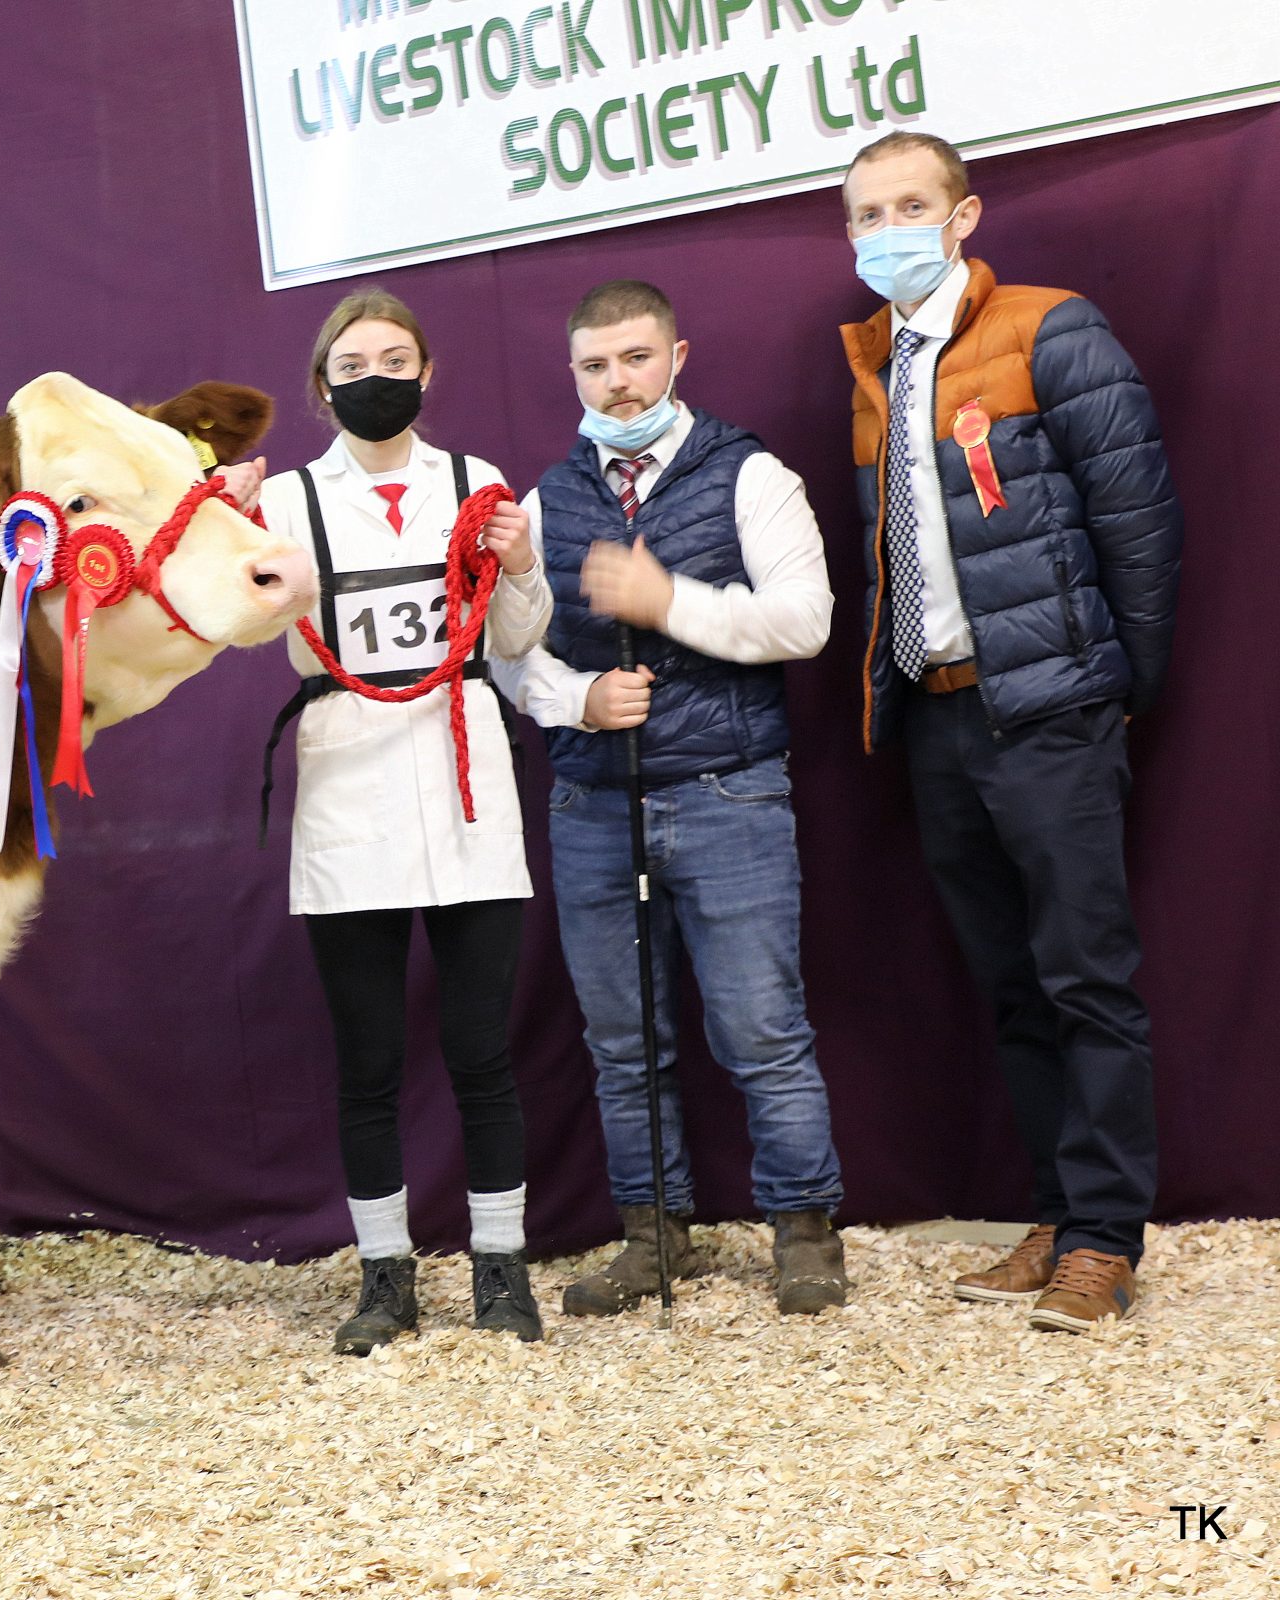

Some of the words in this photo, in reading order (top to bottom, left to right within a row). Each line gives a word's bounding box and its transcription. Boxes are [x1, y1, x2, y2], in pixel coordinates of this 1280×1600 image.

[291, 0, 606, 136] LIVESTOCK
[503, 64, 780, 194] SOCIETY
[812, 35, 927, 130] Ltd
